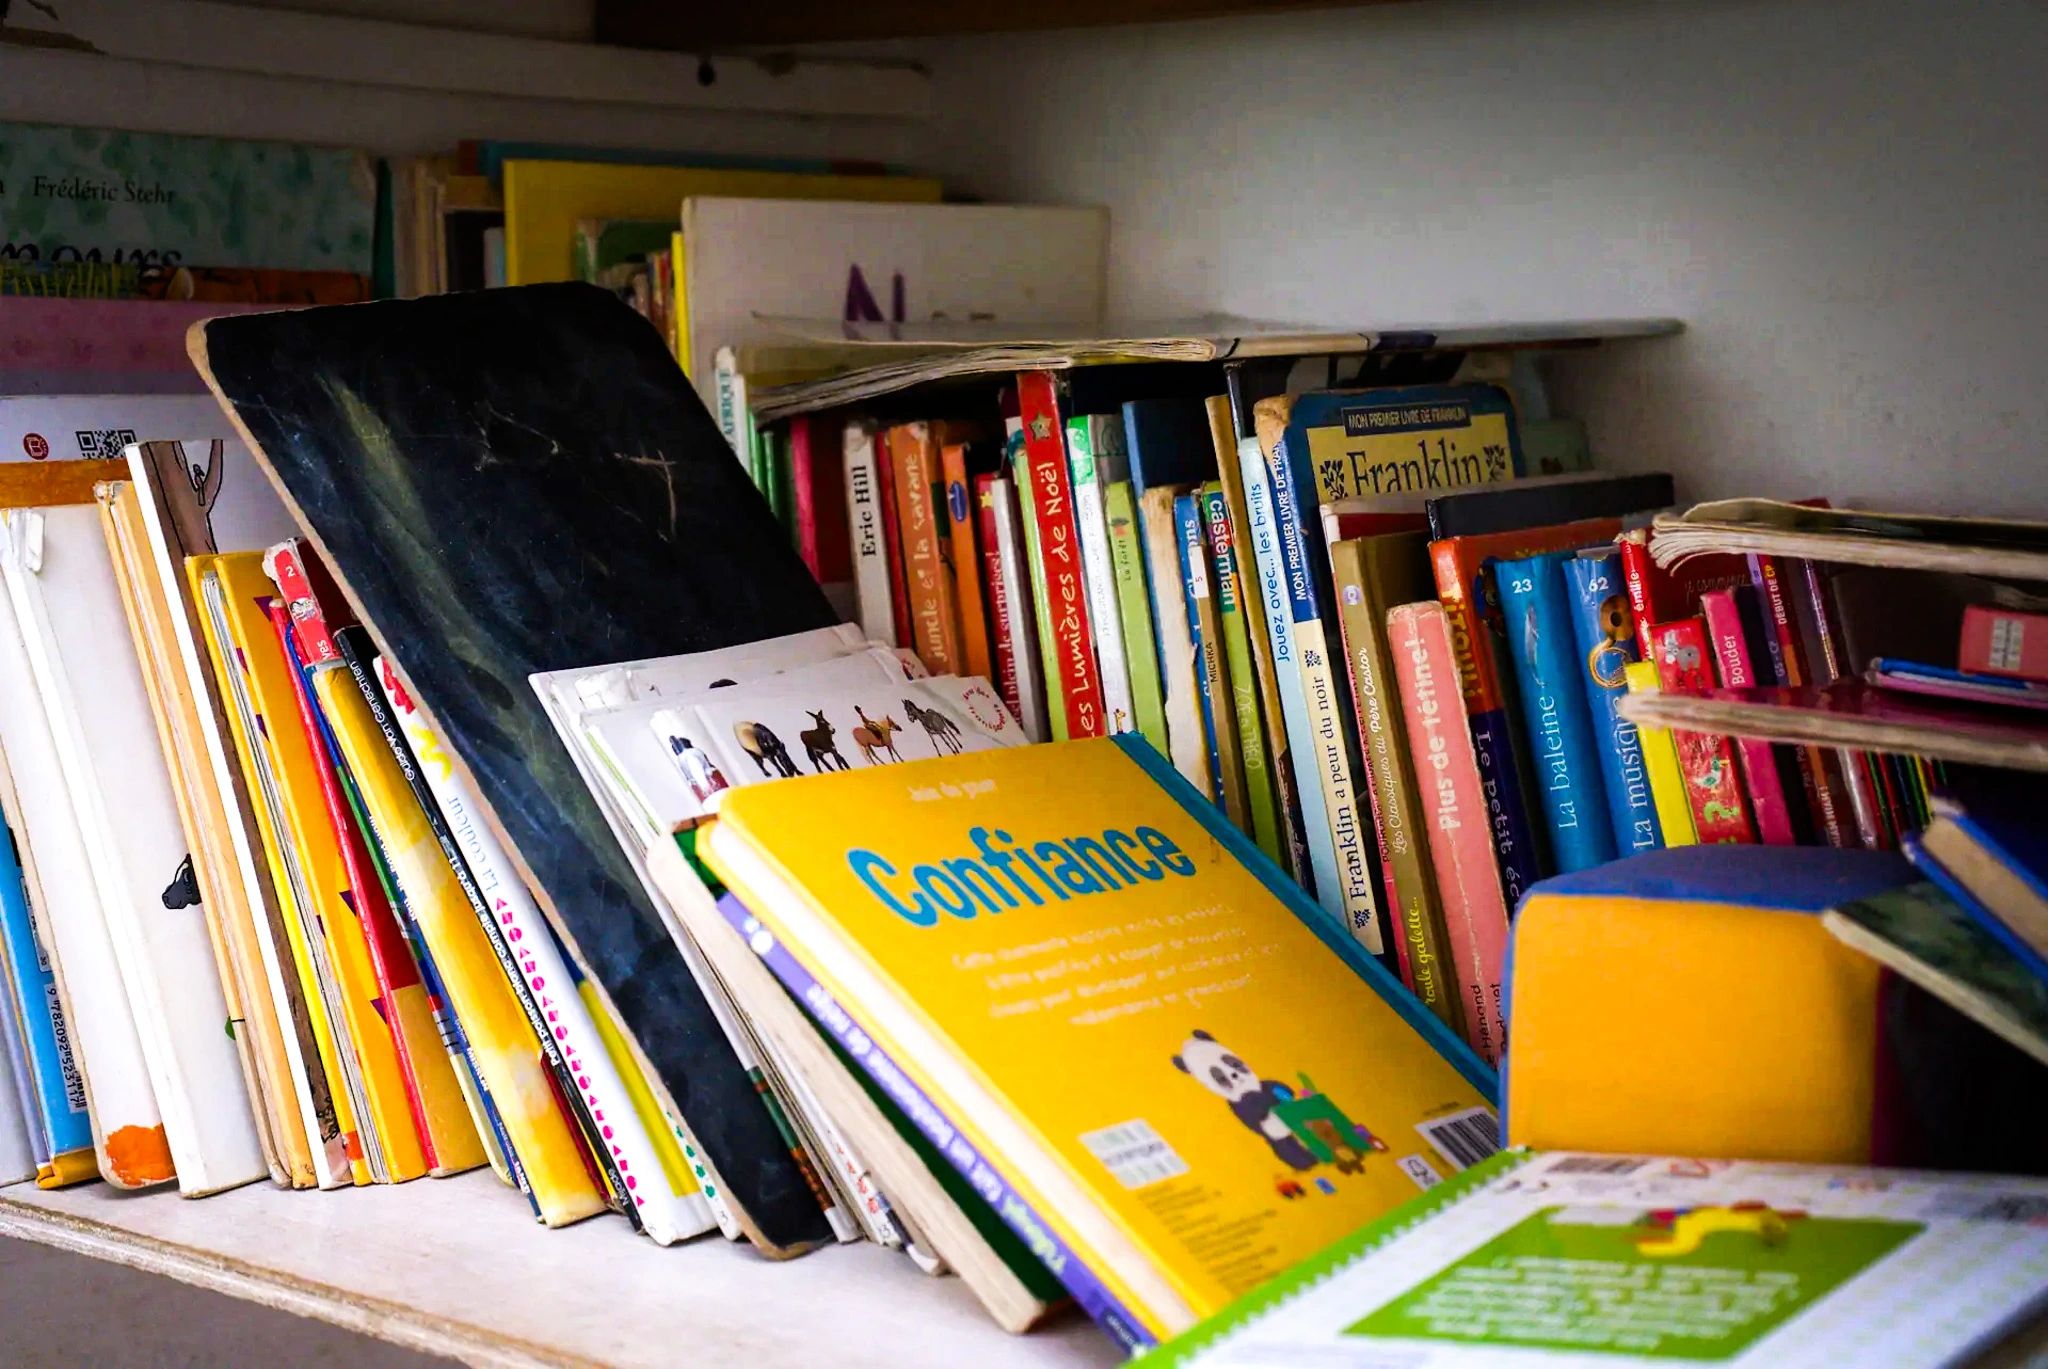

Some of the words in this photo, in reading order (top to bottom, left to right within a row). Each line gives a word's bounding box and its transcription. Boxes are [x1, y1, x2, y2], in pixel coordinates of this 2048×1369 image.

[33, 175, 119, 202] Frédéric
[125, 180, 177, 204] Stehr
[852, 465, 872, 505] Hill
[1275, 470, 1286, 489] DE
[1347, 437, 1483, 496] Franklin
[1036, 461, 1063, 517] Noël
[1251, 484, 1266, 527] bruits
[1276, 490, 1292, 521] LIVRE
[859, 511, 876, 558] Eric
[913, 541, 930, 563] la
[1051, 525, 1070, 562] de
[1209, 499, 1236, 606] casterman
[1259, 531, 1271, 554] les
[1283, 523, 1300, 571] PREMIER
[285, 565, 296, 578] 2
[1293, 573, 1307, 601] MON
[1511, 579, 1533, 594] 23
[1588, 576, 1609, 592] 62
[1629, 570, 1646, 613] émilie
[1059, 574, 1093, 696] Lumières
[1272, 614, 1290, 661] Jouez
[1205, 641, 1218, 684] MICHKA
[1359, 647, 1376, 696] Castor
[1723, 634, 1746, 686] Bouder
[349, 660, 386, 723] Genechten
[1313, 676, 1331, 712] noir
[379, 722, 399, 748] Van
[1320, 720, 1334, 740] du
[1375, 735, 1387, 754] du
[1540, 695, 1572, 793] baleine
[391, 745, 417, 782] Guido
[1328, 747, 1352, 786] peur
[1429, 738, 1454, 771] de
[1612, 697, 1648, 809] musiqu
[1336, 788, 1348, 799] a
[1381, 756, 1401, 828] Classiques
[1438, 777, 1462, 831] Plus
[1475, 730, 1491, 768] Le
[1483, 780, 1512, 856] petit
[445, 795, 486, 864] couleur
[1558, 800, 1579, 831] La
[1633, 818, 1655, 850] La
[1336, 804, 1368, 901] Franklin
[1392, 830, 1407, 856] Les
[477, 867, 500, 891] La
[846, 825, 1197, 929] Confiance
[477, 911, 509, 959] compte
[501, 959, 524, 993] blanc
[518, 993, 549, 1039] poisson
[49, 1004, 69, 1052] 782092
[60, 1056, 79, 1104] 523117
[540, 1038, 561, 1066] Petit
